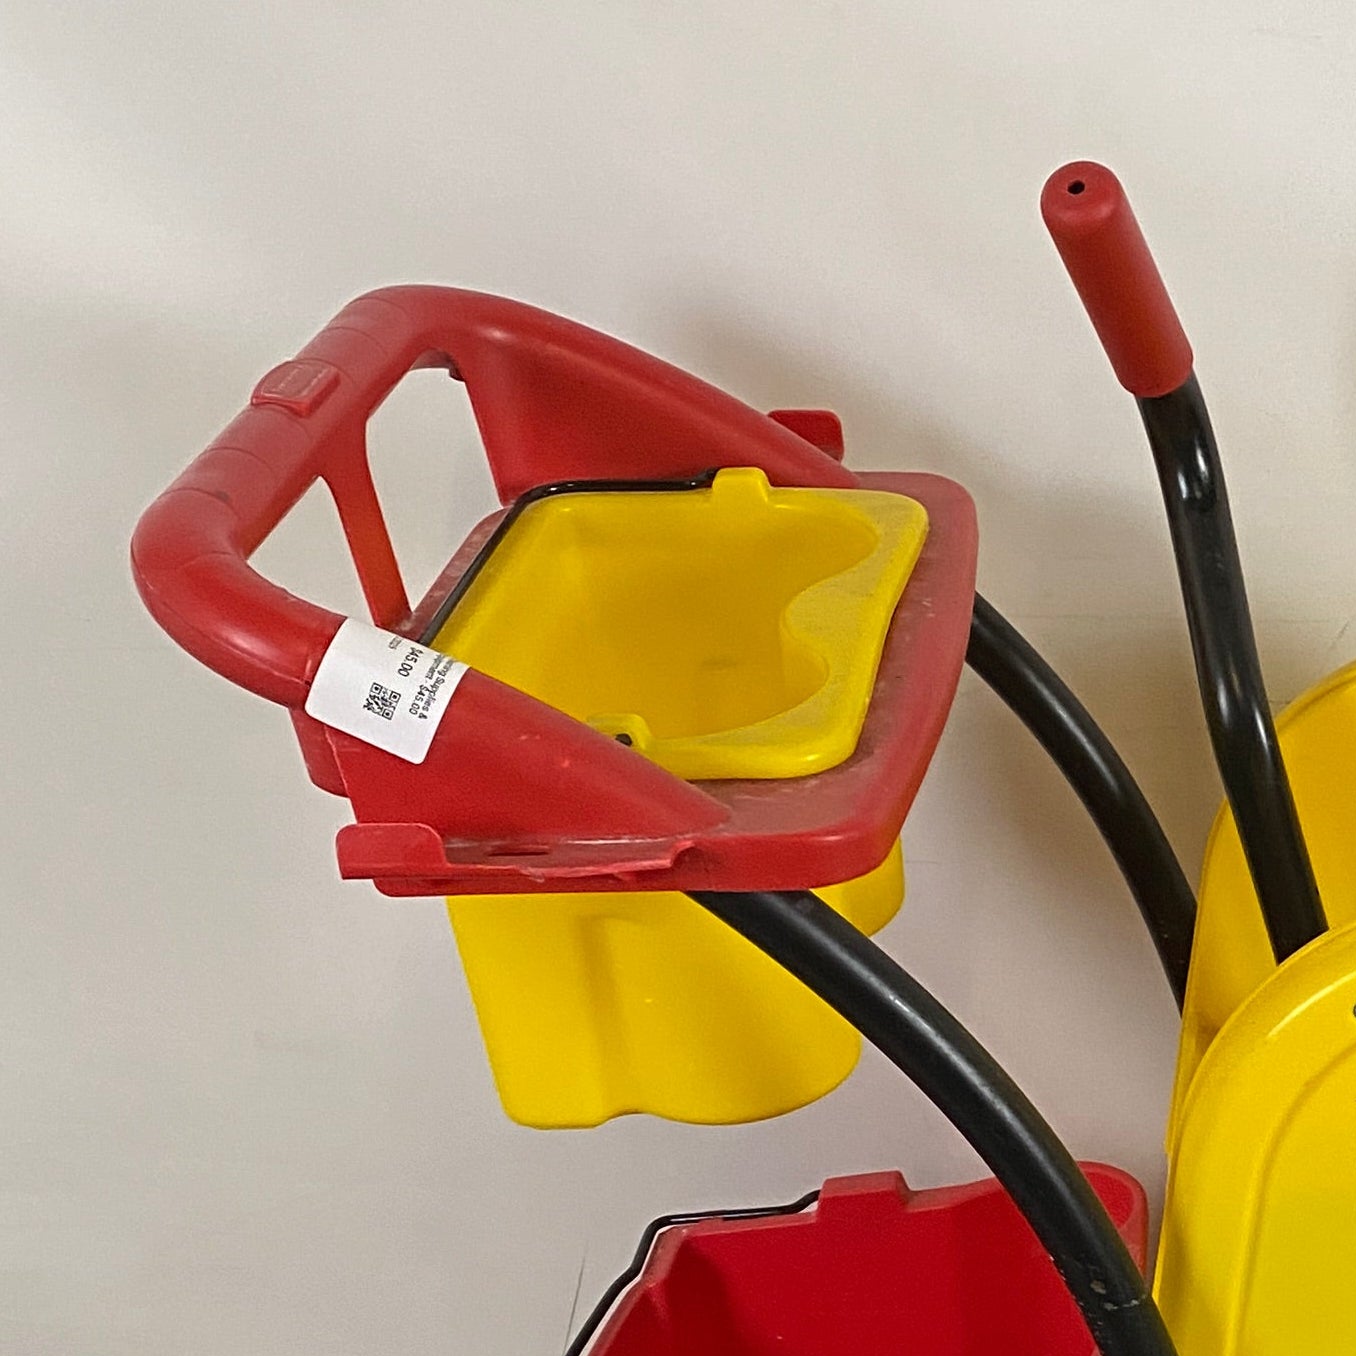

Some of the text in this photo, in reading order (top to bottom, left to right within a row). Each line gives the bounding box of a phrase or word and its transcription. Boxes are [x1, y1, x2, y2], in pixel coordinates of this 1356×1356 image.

[398, 647, 424, 677] $45.00
[409, 685, 432, 715] $45.00
[422, 677, 446, 712] Supplies
